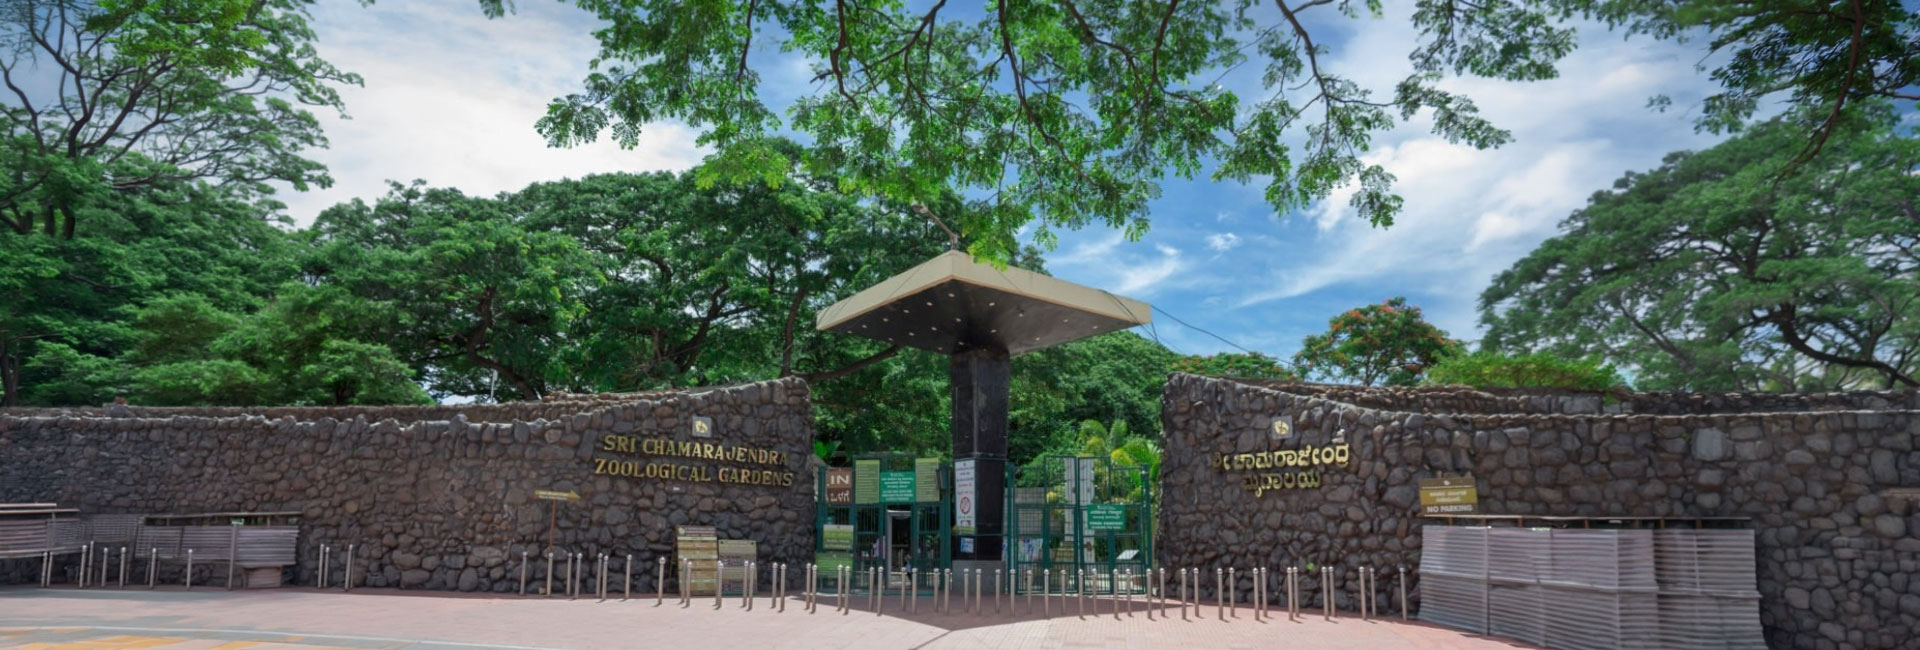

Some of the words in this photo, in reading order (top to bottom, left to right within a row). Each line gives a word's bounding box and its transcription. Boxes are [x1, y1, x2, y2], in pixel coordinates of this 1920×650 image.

[603, 434, 635, 453] SRI
[642, 438, 790, 466] CHAMARAJENDRA
[594, 458, 711, 482] ZOOLOGICAL
[718, 467, 794, 487] GARDENS
[1440, 504, 1473, 513] PARKING
